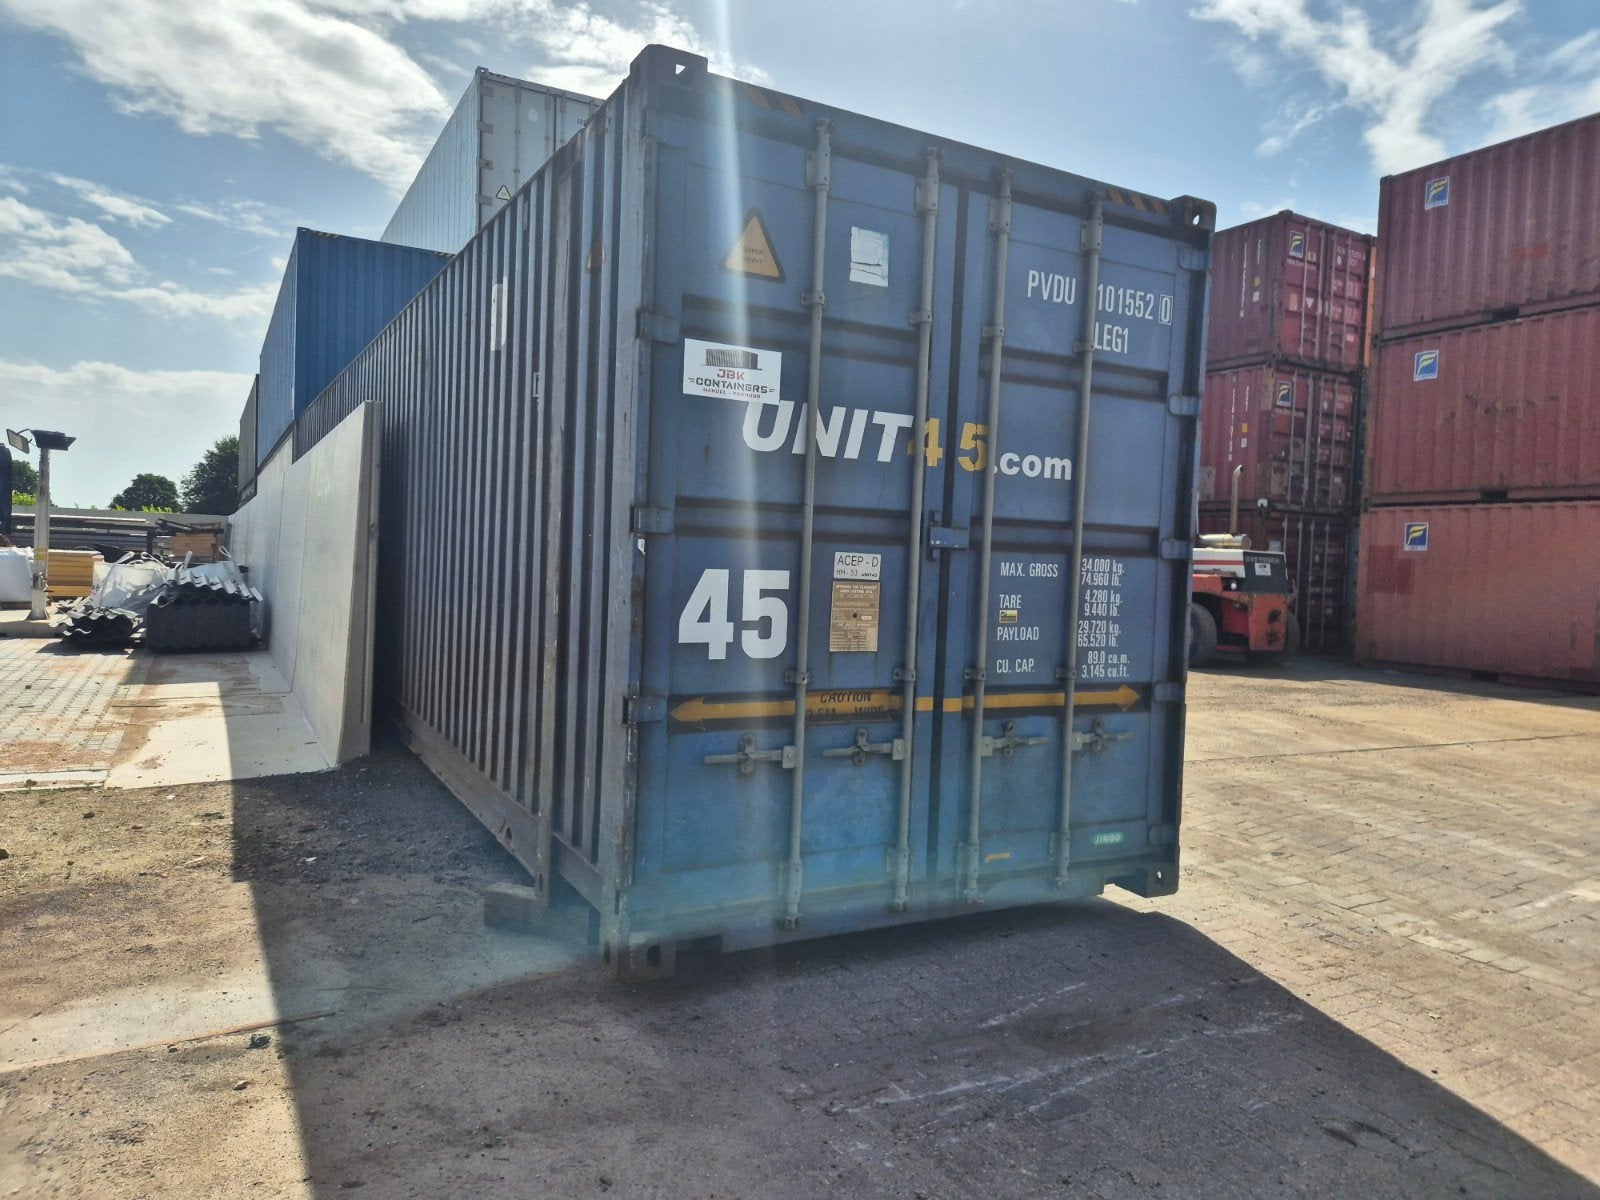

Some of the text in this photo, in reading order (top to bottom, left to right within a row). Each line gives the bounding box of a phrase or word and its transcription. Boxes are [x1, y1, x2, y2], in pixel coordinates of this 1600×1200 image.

[1027, 269, 1076, 305] PVDU
[1097, 283, 1153, 320] 101552
[717, 368, 746, 380] JBK
[695, 377, 768, 394] CONTAINERS
[1000, 558, 1125, 578] MAX. GROSS 34.000 kg.
[1081, 571, 1121, 586] 74.960 lb.
[999, 589, 1123, 609] TARE 4.280 kg.
[678, 568, 790, 660] 45
[1084, 602, 1120, 616] 9.440 lb.
[997, 620, 1122, 641] PAYLOAD 29.720 kg.
[1077, 633, 1119, 647] 65.520 lb.
[996, 659, 1011, 673] CU.
[1015, 658, 1035, 673] CAP.
[1087, 650, 1105, 664] 89.0
[820, 691, 873, 703] CAUTION
